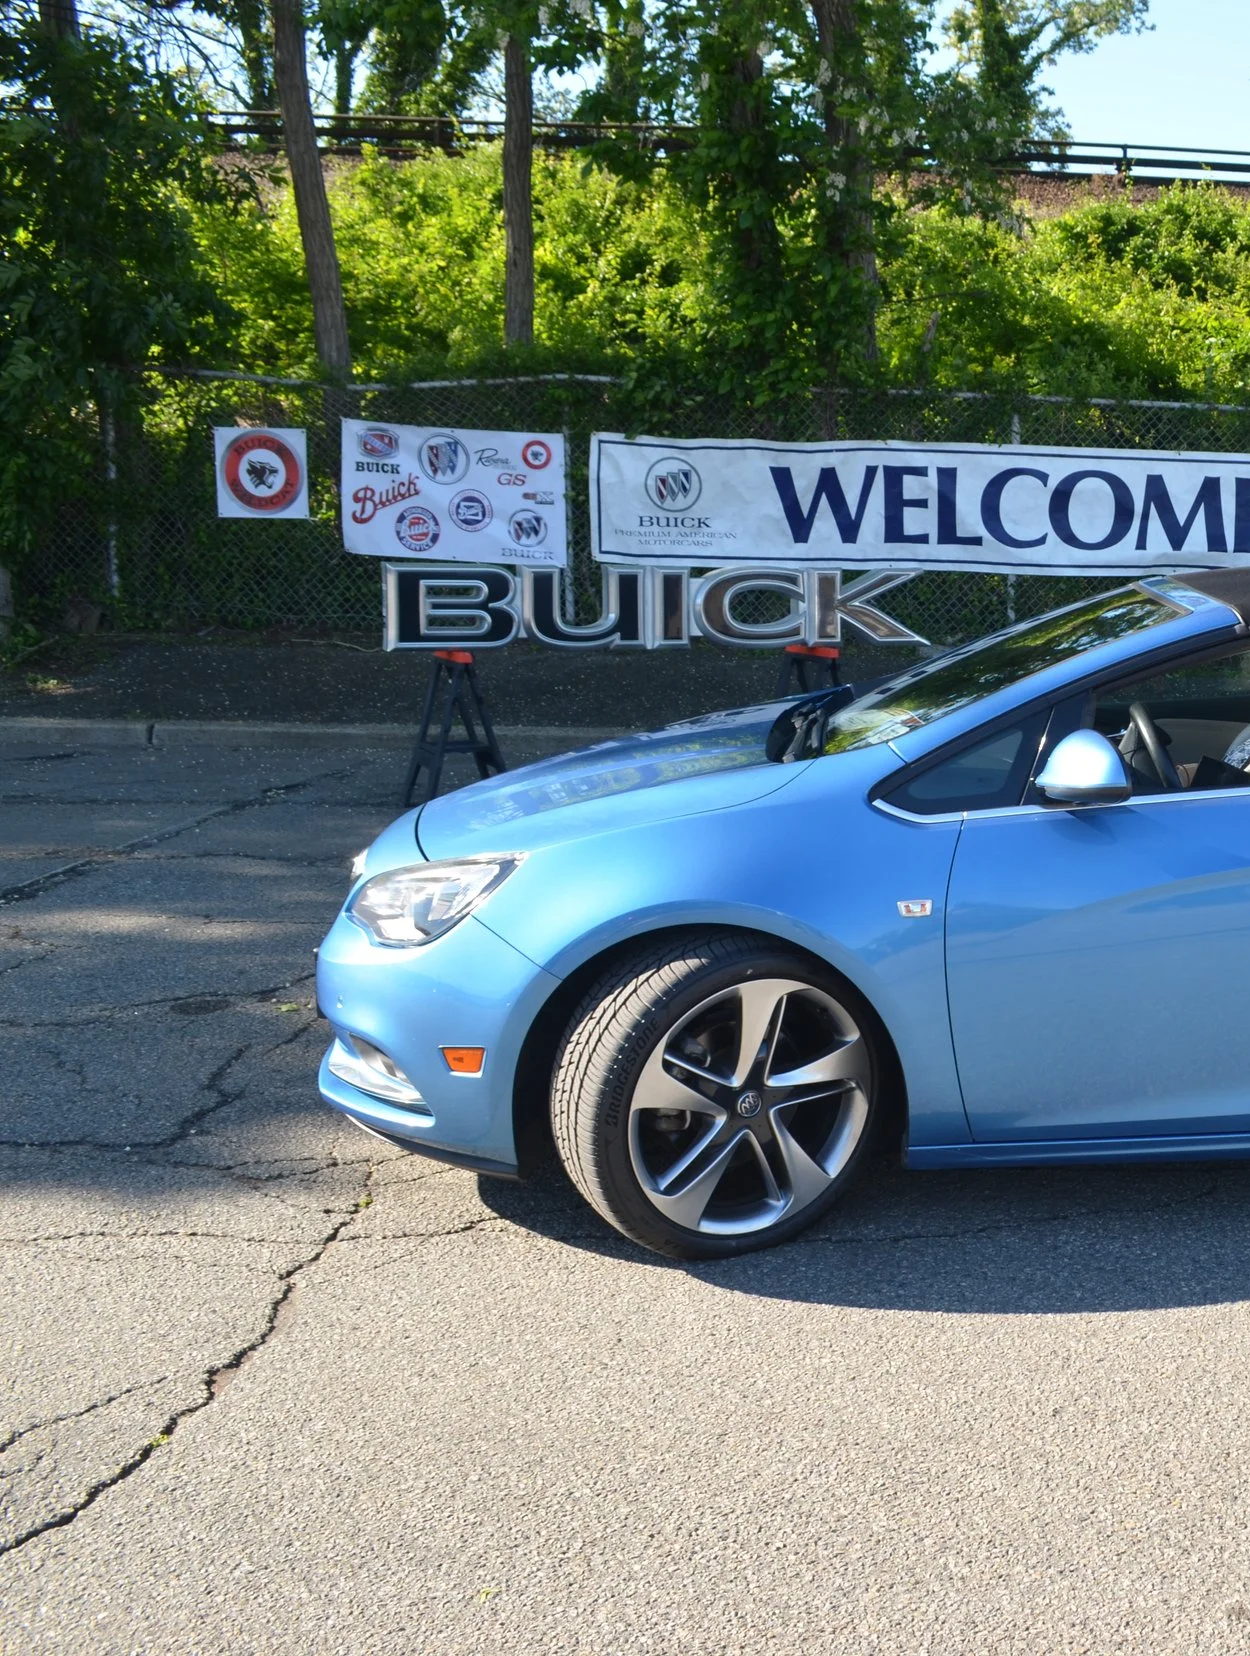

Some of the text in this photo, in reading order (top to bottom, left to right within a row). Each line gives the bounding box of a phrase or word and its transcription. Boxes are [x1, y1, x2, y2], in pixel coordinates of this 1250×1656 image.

[355, 461, 400, 475] BUICK
[496, 472, 528, 488] GS
[351, 472, 421, 525] Buick
[638, 515, 713, 529] BUICK
[614, 529, 738, 540] PREMIUM AMERICAN
[637, 539, 714, 548] MOTORCARS
[501, 548, 556, 561] BUICK
[382, 562, 932, 652] BUICK
[605, 1018, 661, 1128] BRIDGESTONE
